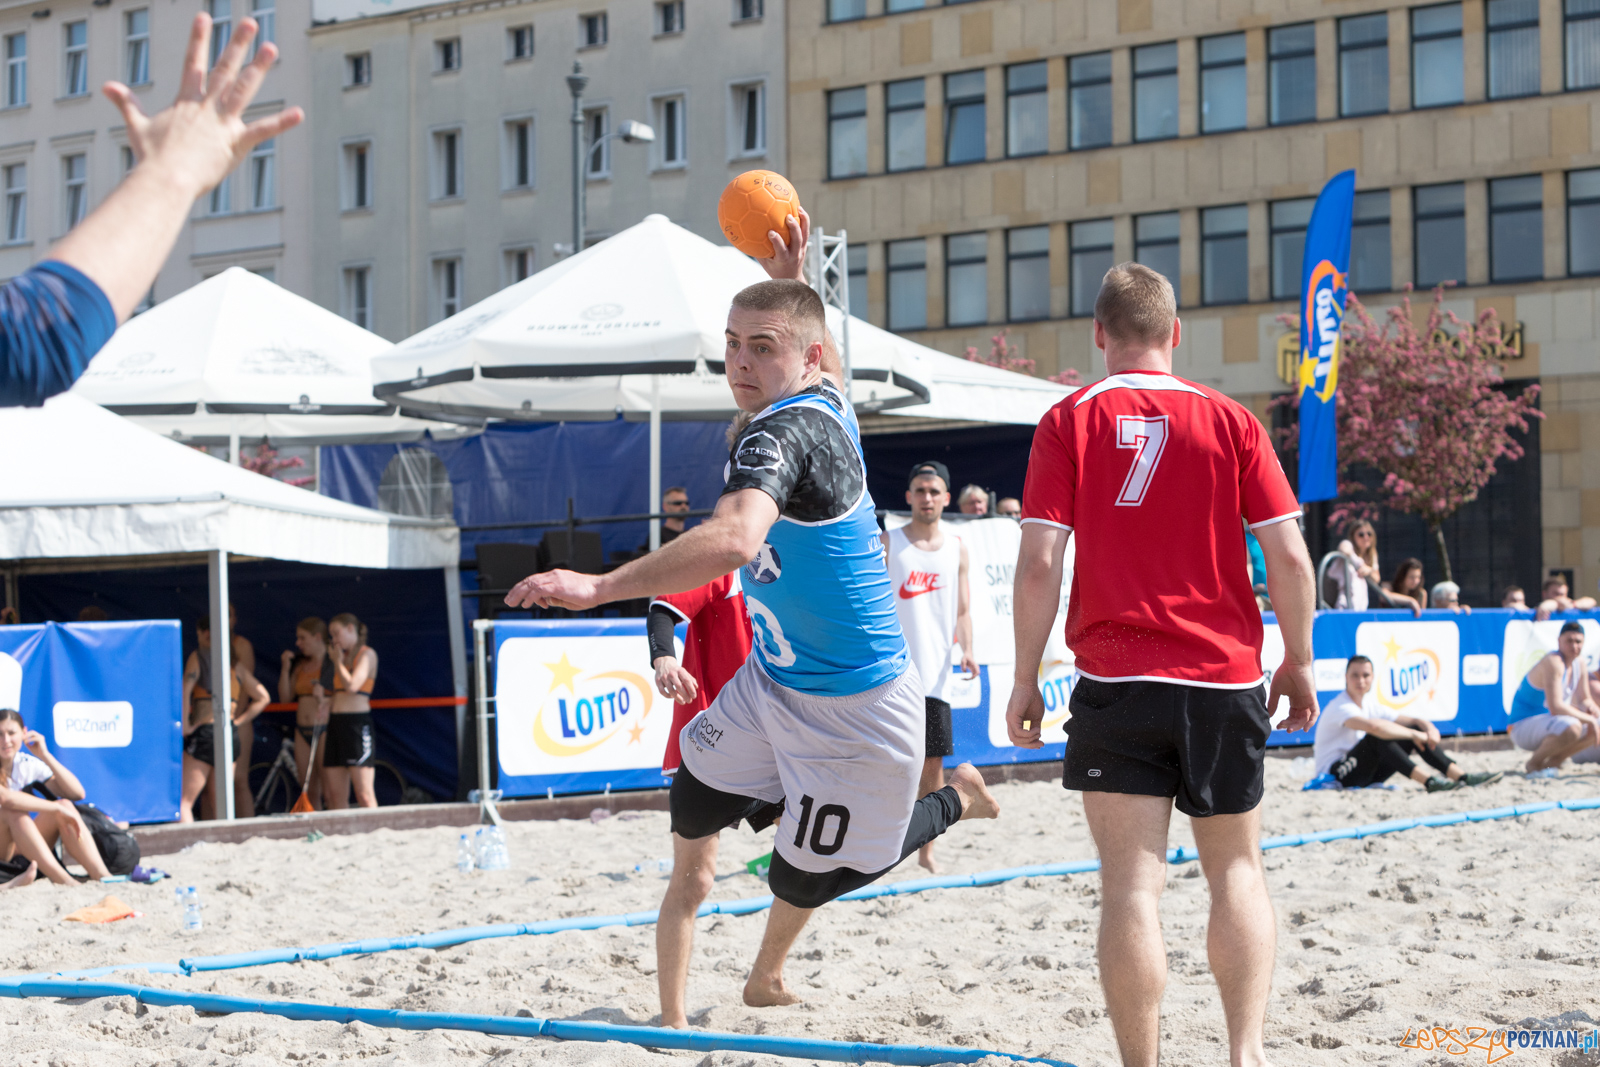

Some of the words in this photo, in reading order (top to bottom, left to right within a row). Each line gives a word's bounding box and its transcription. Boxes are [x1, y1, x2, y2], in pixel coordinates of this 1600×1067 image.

[738, 447, 780, 460] OCTAGON
[1114, 414, 1169, 507] 7
[907, 570, 940, 589] NIKE
[1390, 660, 1429, 697] LOTTO
[558, 687, 630, 738] LOTTO
[793, 793, 851, 856] 10
